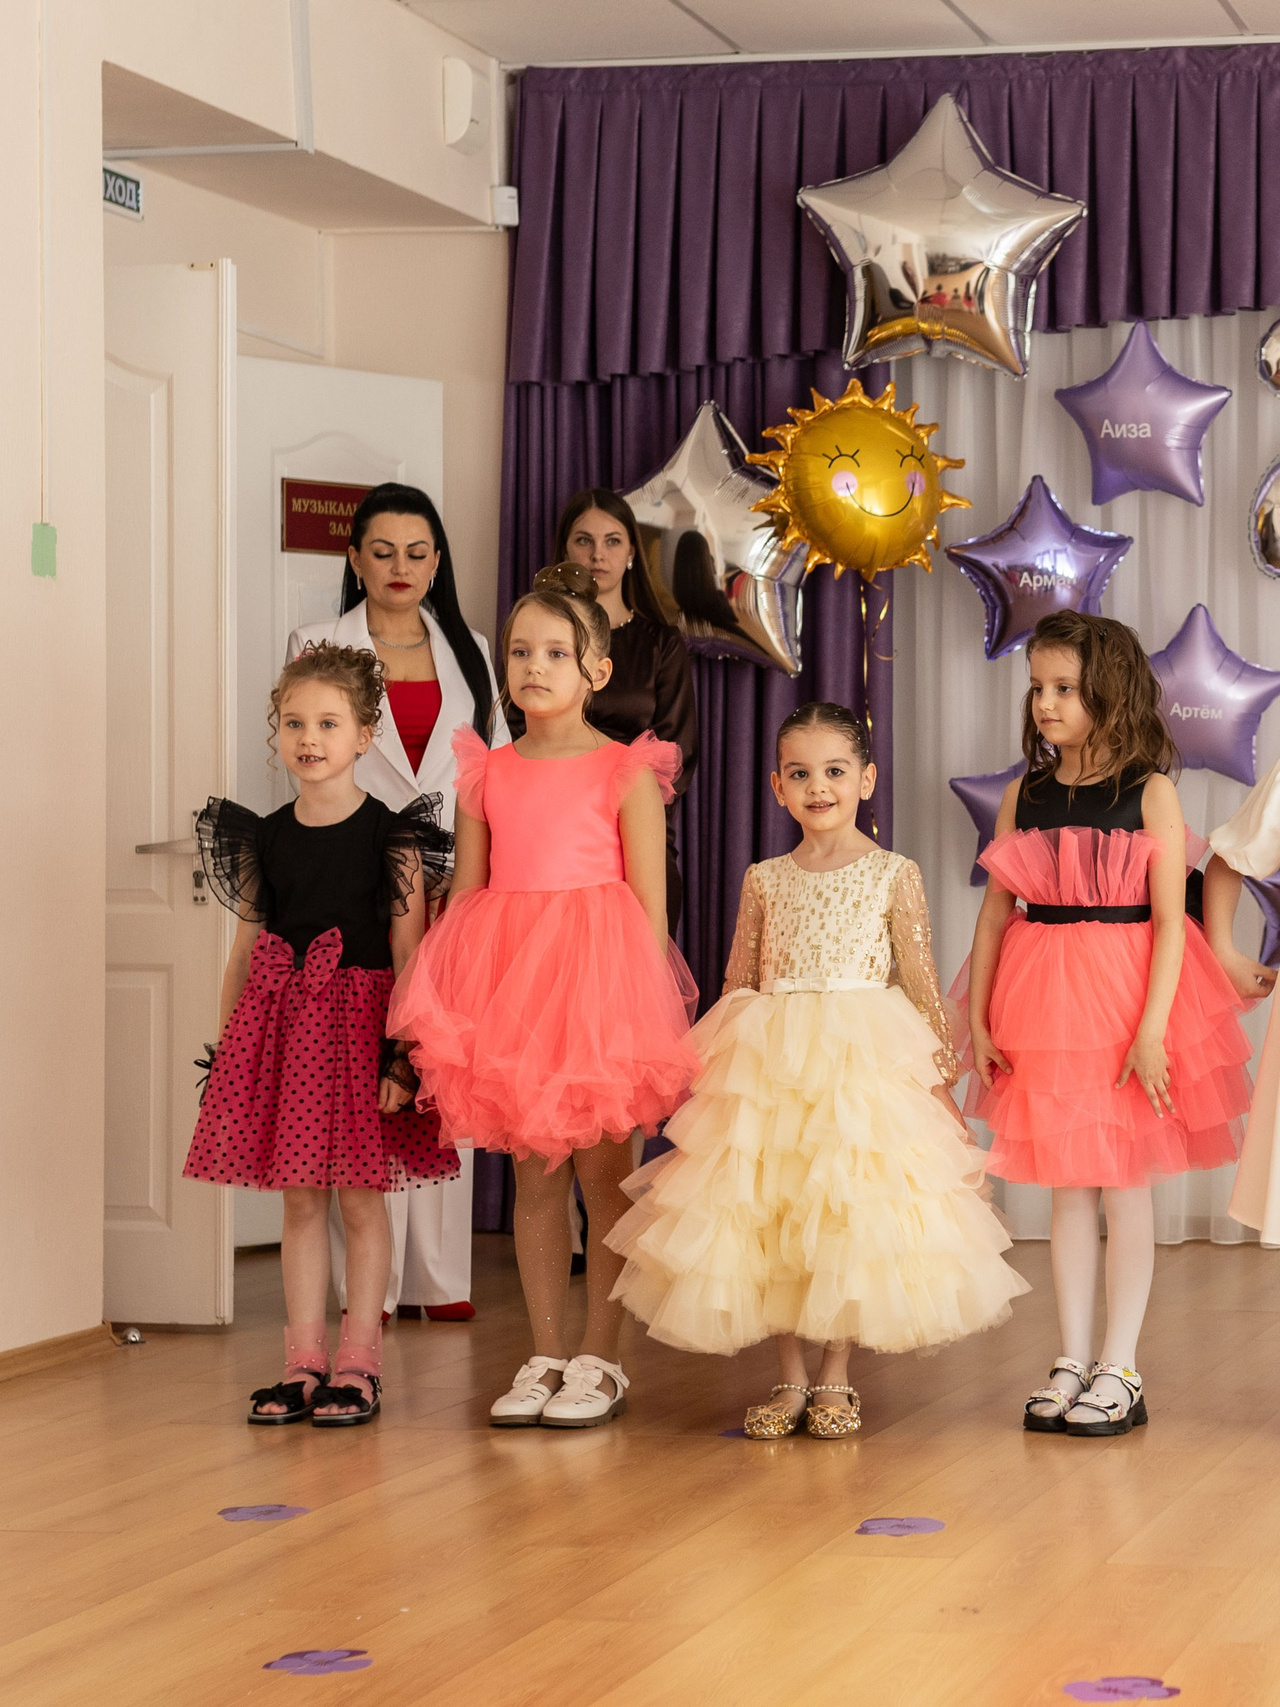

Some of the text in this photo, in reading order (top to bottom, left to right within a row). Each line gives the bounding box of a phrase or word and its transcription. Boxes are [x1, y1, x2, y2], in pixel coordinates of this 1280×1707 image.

[102, 171, 137, 209] ХОД
[1100, 418, 1152, 438] Аиза
[329, 521, 352, 536] ЗАЛ
[1169, 702, 1223, 721] Артём
